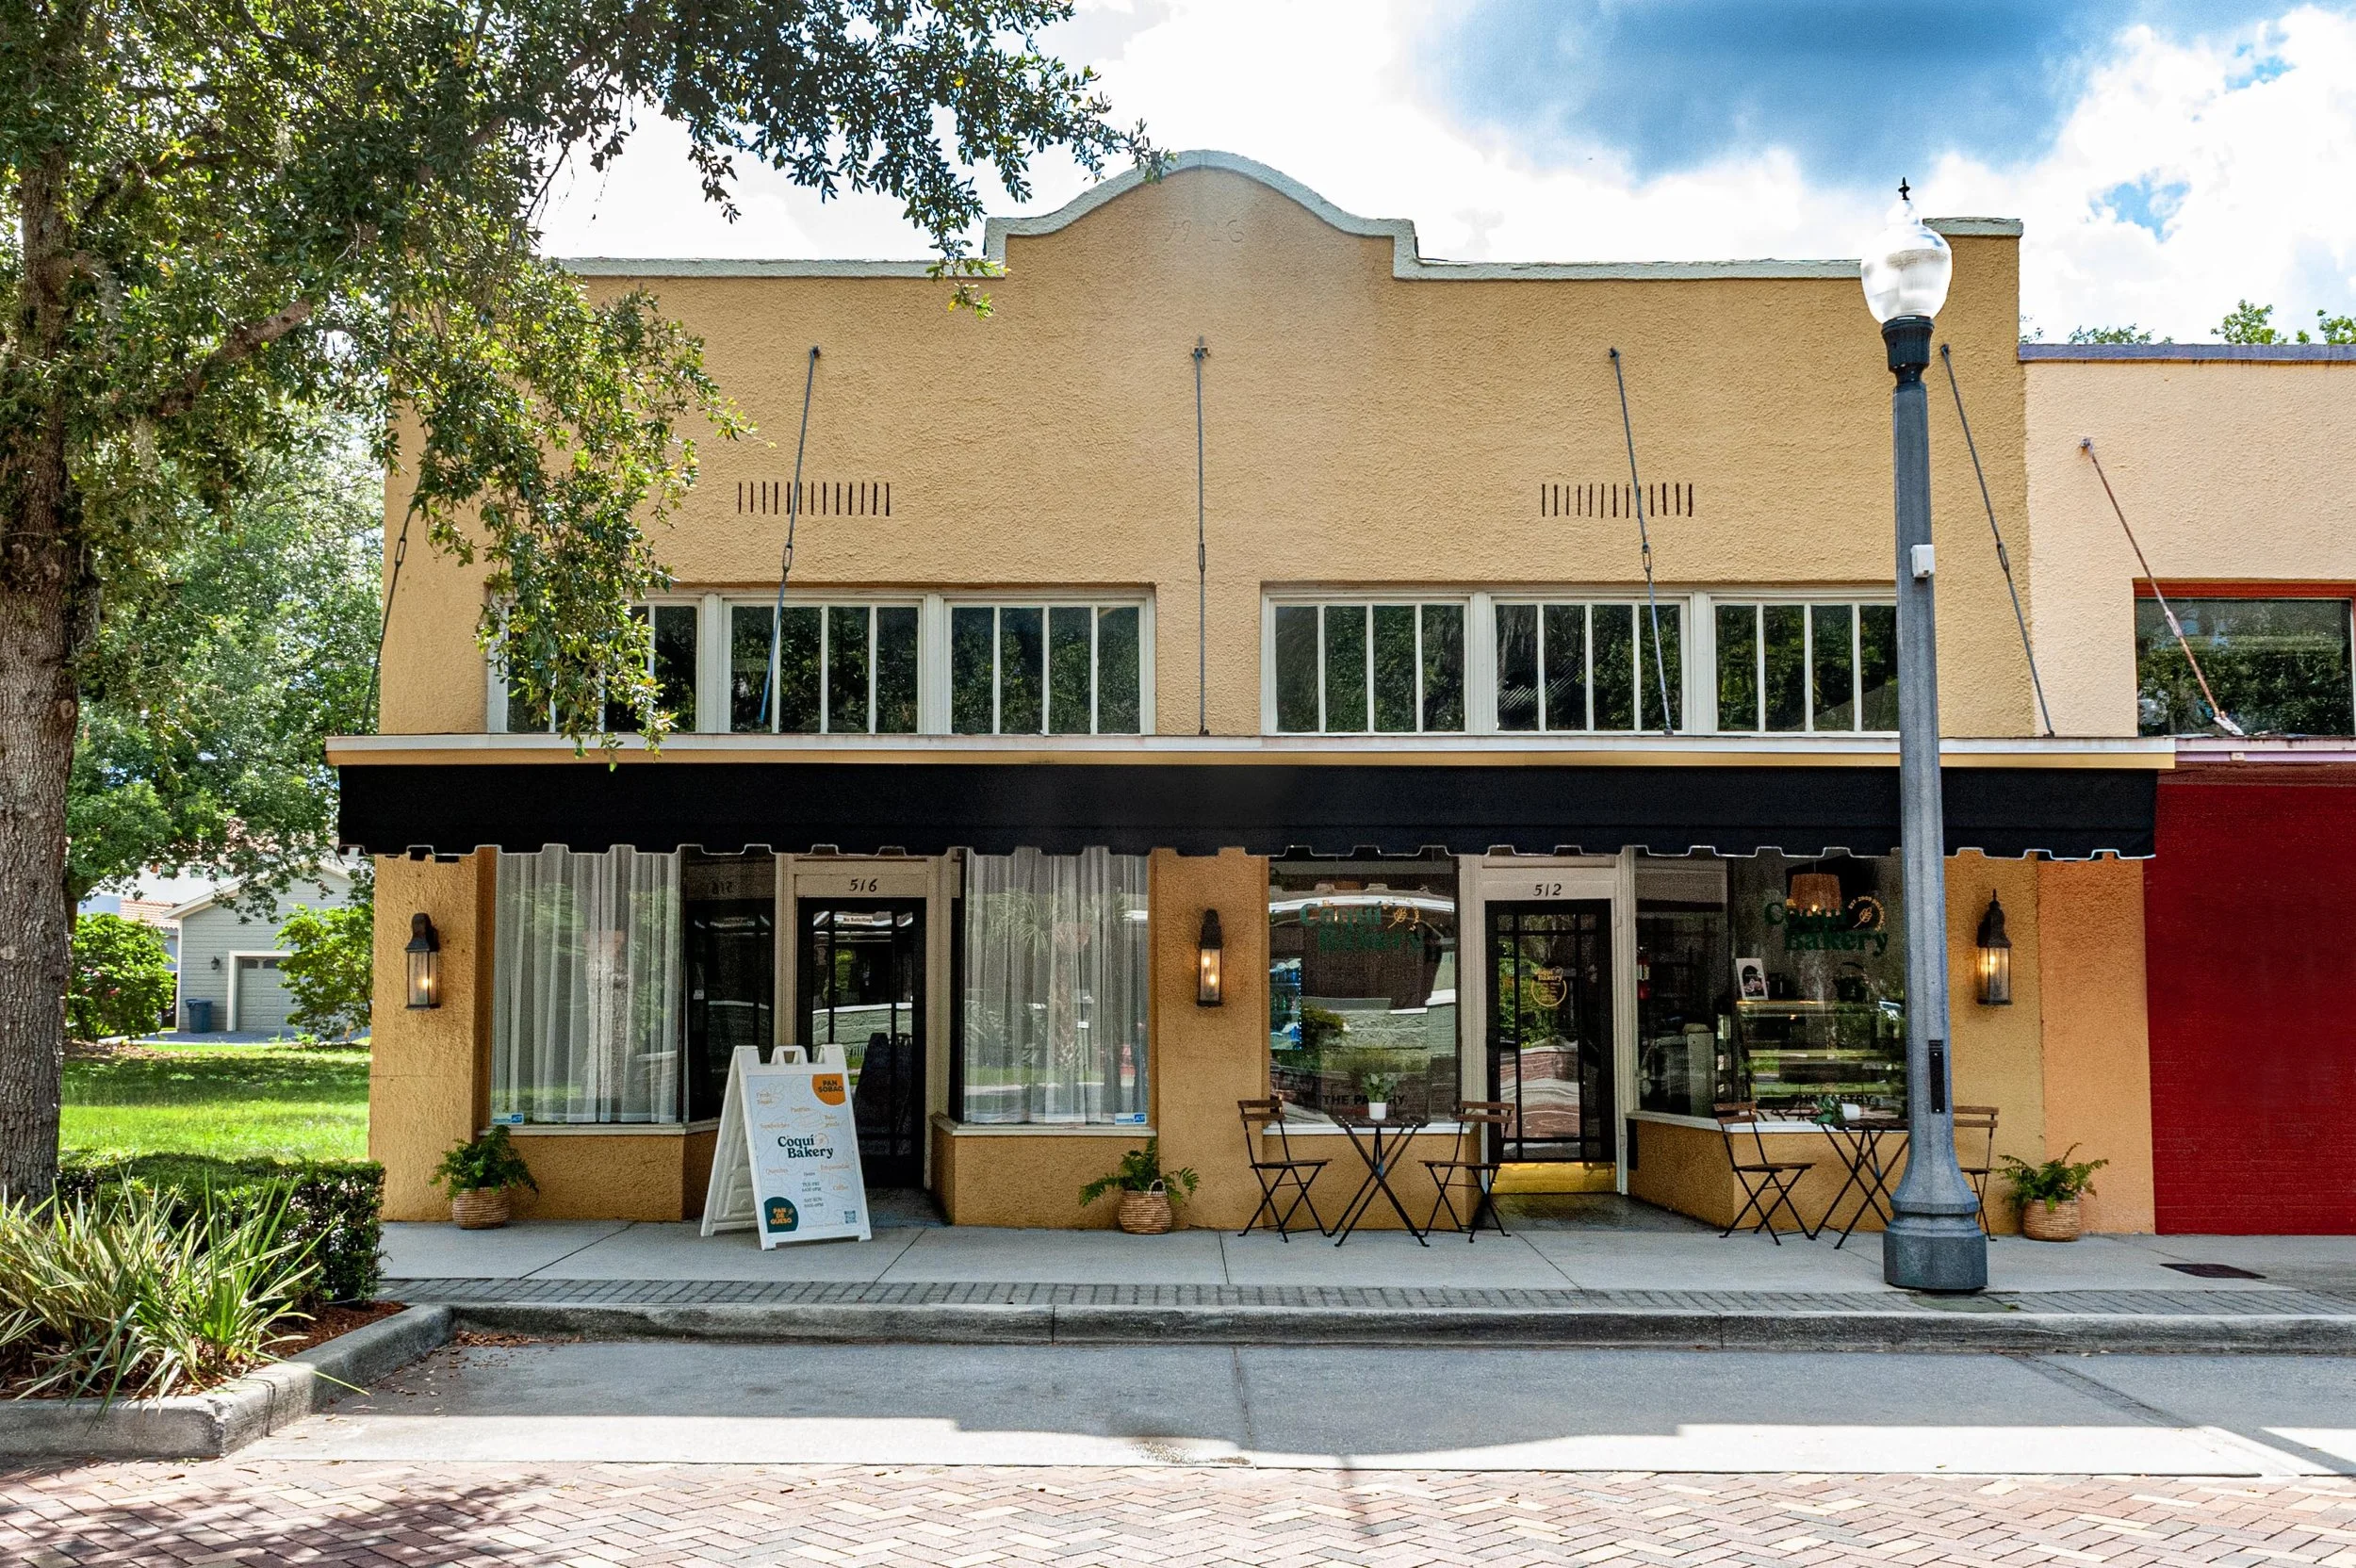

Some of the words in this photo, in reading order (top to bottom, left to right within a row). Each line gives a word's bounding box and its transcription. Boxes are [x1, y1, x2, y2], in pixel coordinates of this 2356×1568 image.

[848, 877, 878, 892] 516
[1532, 883, 1562, 897] 512
[1785, 929, 1888, 956] Bakery
[1323, 1094, 1349, 1105] THE
[777, 1134, 815, 1149] Coquí
[788, 1147, 834, 1159] Bakery
